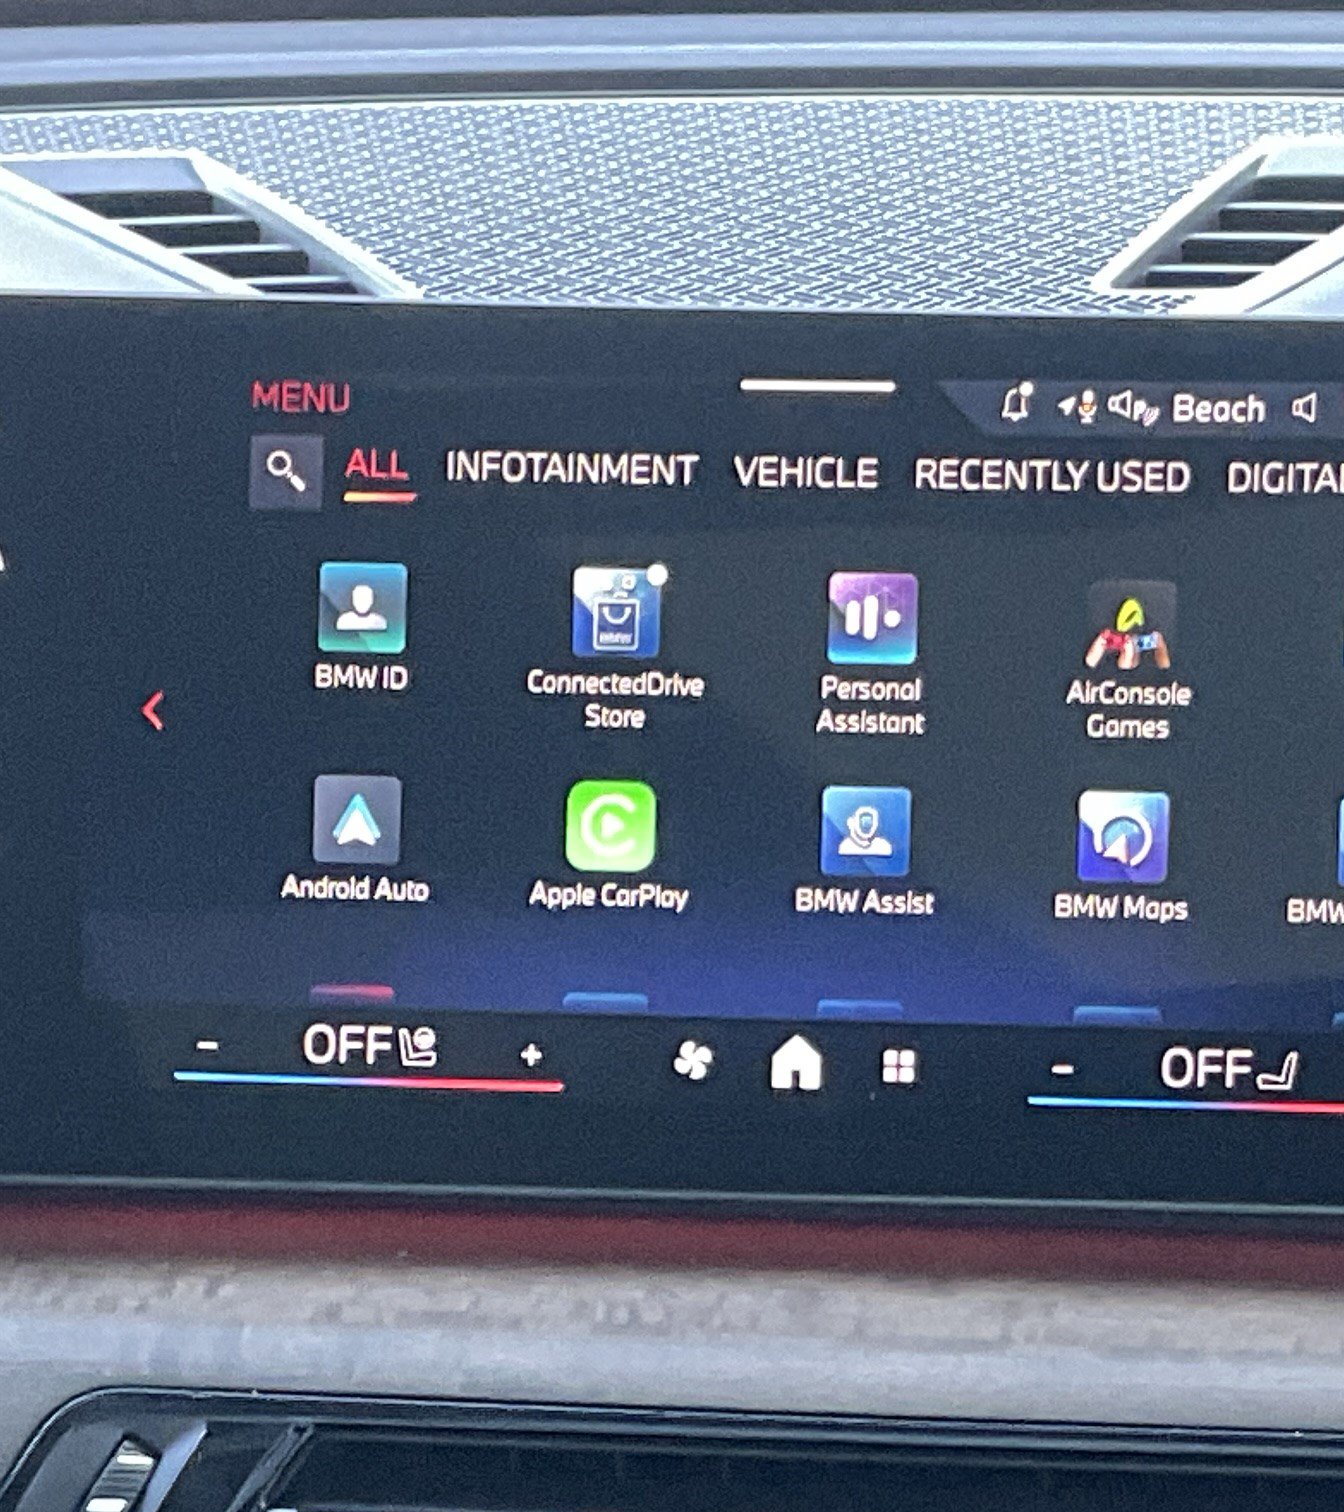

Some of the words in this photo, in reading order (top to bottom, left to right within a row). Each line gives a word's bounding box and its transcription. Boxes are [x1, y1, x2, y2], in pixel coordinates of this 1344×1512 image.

[251, 380, 351, 414] MENU
[1173, 393, 1265, 423] Beach
[344, 448, 409, 481] ALL
[446, 450, 701, 487] INFOTAINMENT
[734, 455, 879, 490] VEHICLE
[914, 458, 1090, 493] RECENTLY
[1096, 461, 1190, 494] USED
[314, 664, 378, 690] BMW
[382, 665, 408, 691] ID
[527, 669, 704, 698] ConnectedDrive
[821, 675, 922, 701] Personal
[1066, 681, 1191, 707] AirConsole
[585, 704, 646, 729] Store
[816, 708, 926, 735] Assistant
[1087, 714, 1170, 740] Games
[281, 873, 370, 901] Android
[373, 876, 430, 903] Auto
[529, 880, 597, 909] Apple
[601, 882, 689, 914] CarPlay
[794, 887, 860, 914] BMW
[862, 889, 935, 915] Assist
[1054, 893, 1119, 919] BMW
[1123, 895, 1188, 923] Maps
[303, 1024, 392, 1066] OFF
[1161, 1047, 1253, 1090] OFF
